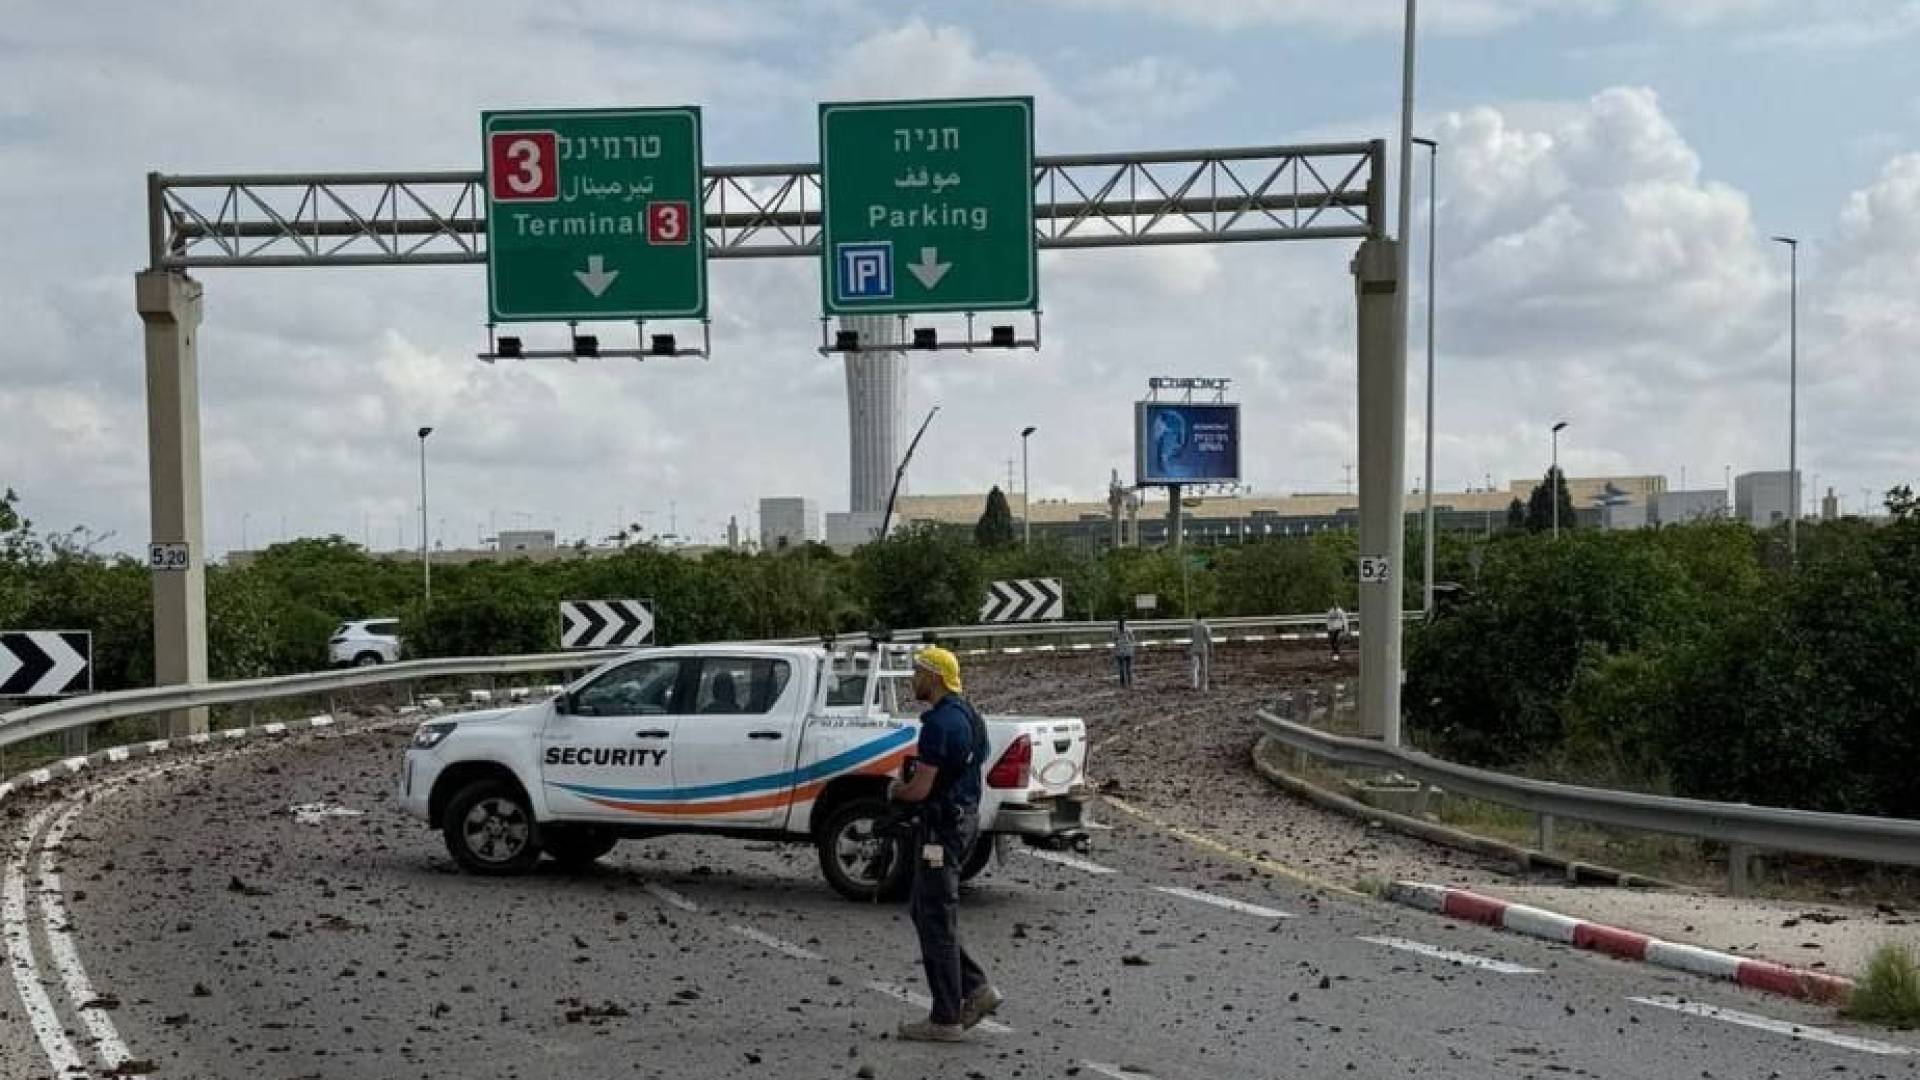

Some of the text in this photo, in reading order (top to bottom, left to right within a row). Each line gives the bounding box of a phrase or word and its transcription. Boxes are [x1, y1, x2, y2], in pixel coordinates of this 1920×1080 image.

[894, 127, 960, 152] חניה
[507, 138, 544, 193] 3
[894, 165, 961, 193] موقف
[513, 206, 681, 239] Terminal 3
[868, 203, 988, 230] Parking
[545, 747, 667, 768] SECURITY
